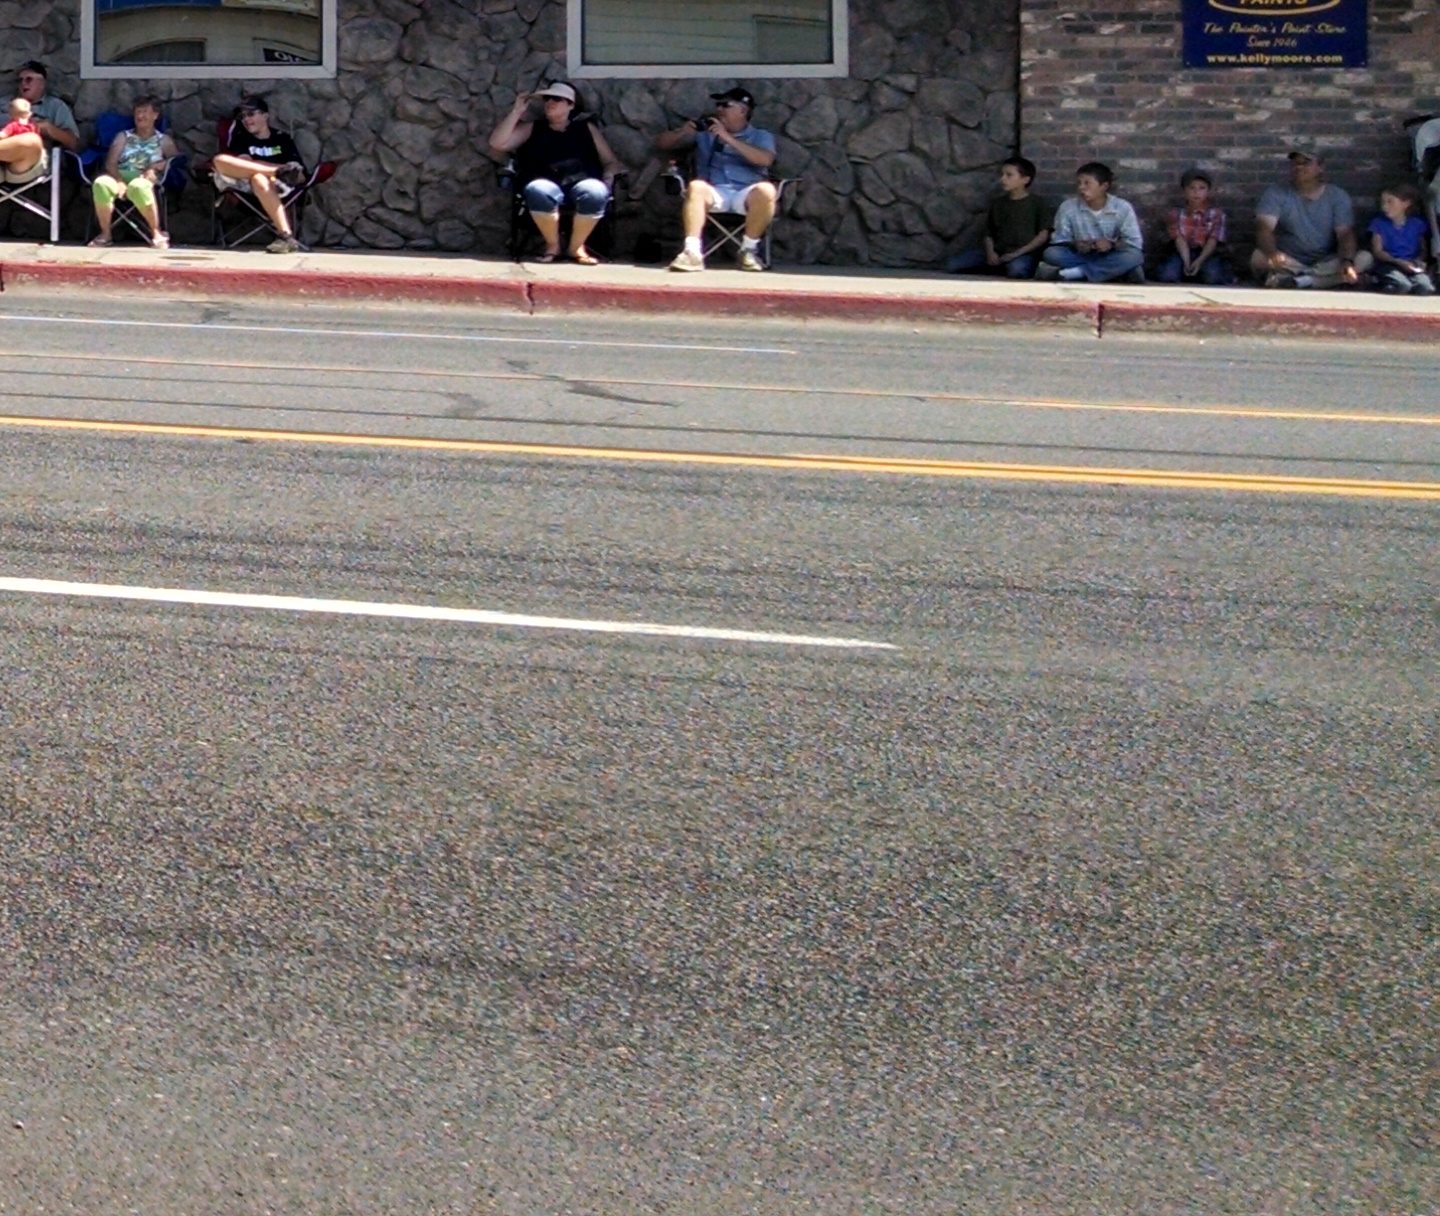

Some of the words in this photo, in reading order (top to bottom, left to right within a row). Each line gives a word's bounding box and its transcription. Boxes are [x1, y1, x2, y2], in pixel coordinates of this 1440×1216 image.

[1203, 22, 1224, 34] The
[1229, 22, 1276, 34] Painter's
[1281, 22, 1312, 34] Paint
[1314, 22, 1347, 34] Store
[1272, 37, 1298, 48] 1946
[1206, 53, 1343, 66] www.kellymoore.com
